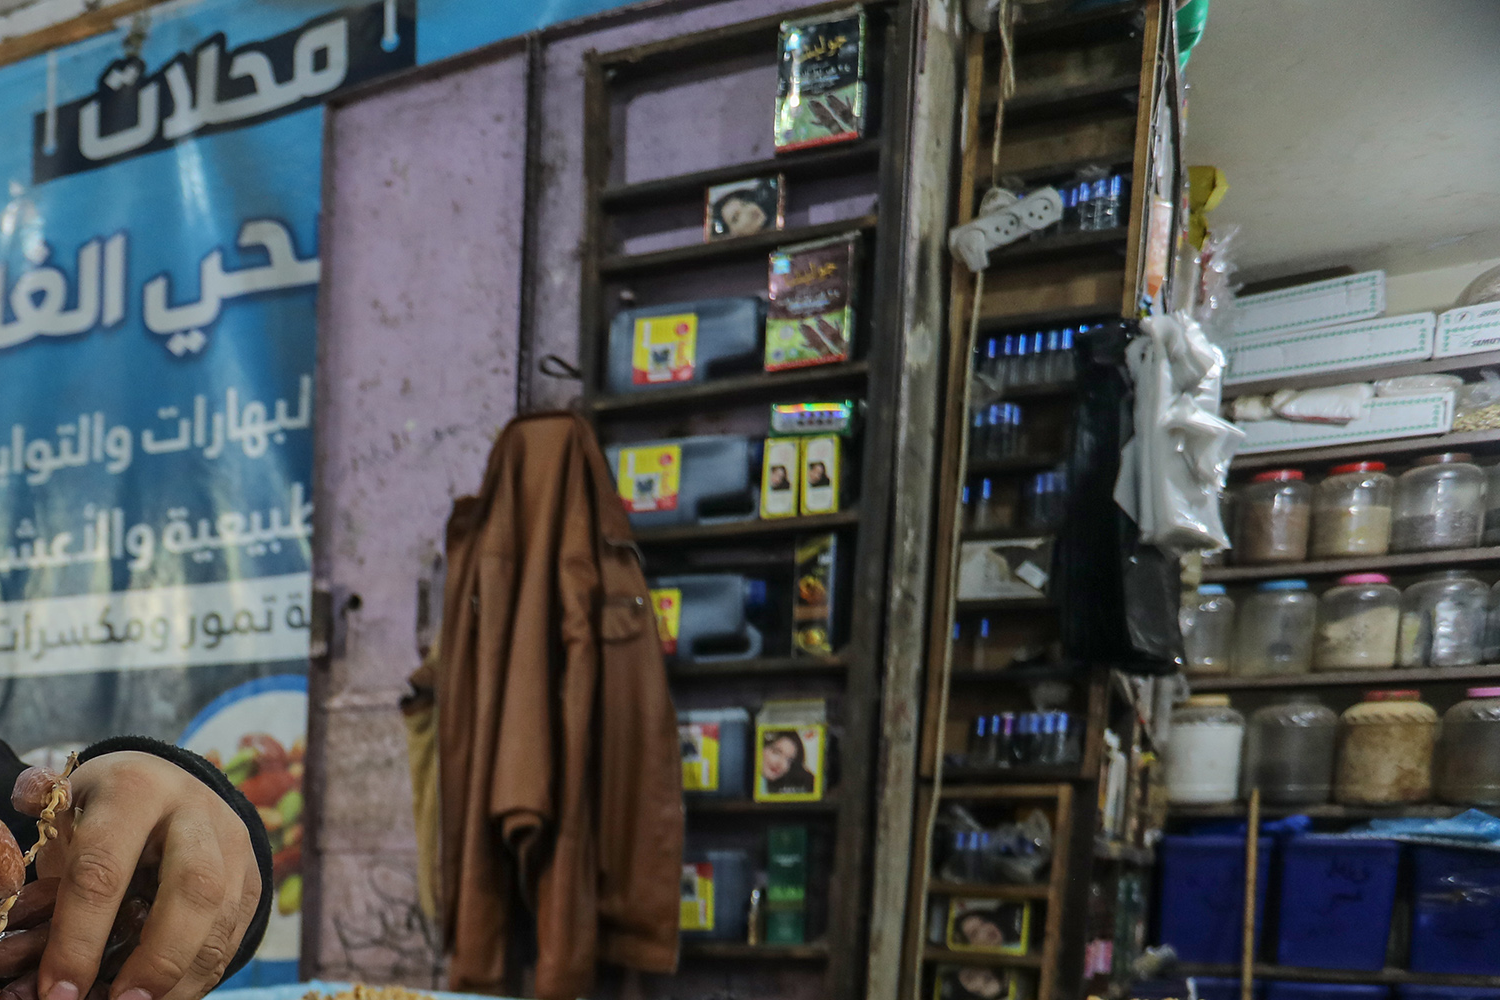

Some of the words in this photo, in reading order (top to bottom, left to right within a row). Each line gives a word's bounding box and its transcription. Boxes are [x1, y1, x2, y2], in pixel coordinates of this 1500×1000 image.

[79, 17, 348, 161] محلات
[144, 219, 320, 357] حي
[141, 375, 311, 459] لبهارات
[162, 482, 313, 561] طبيعية
[185, 595, 274, 650] تمور
